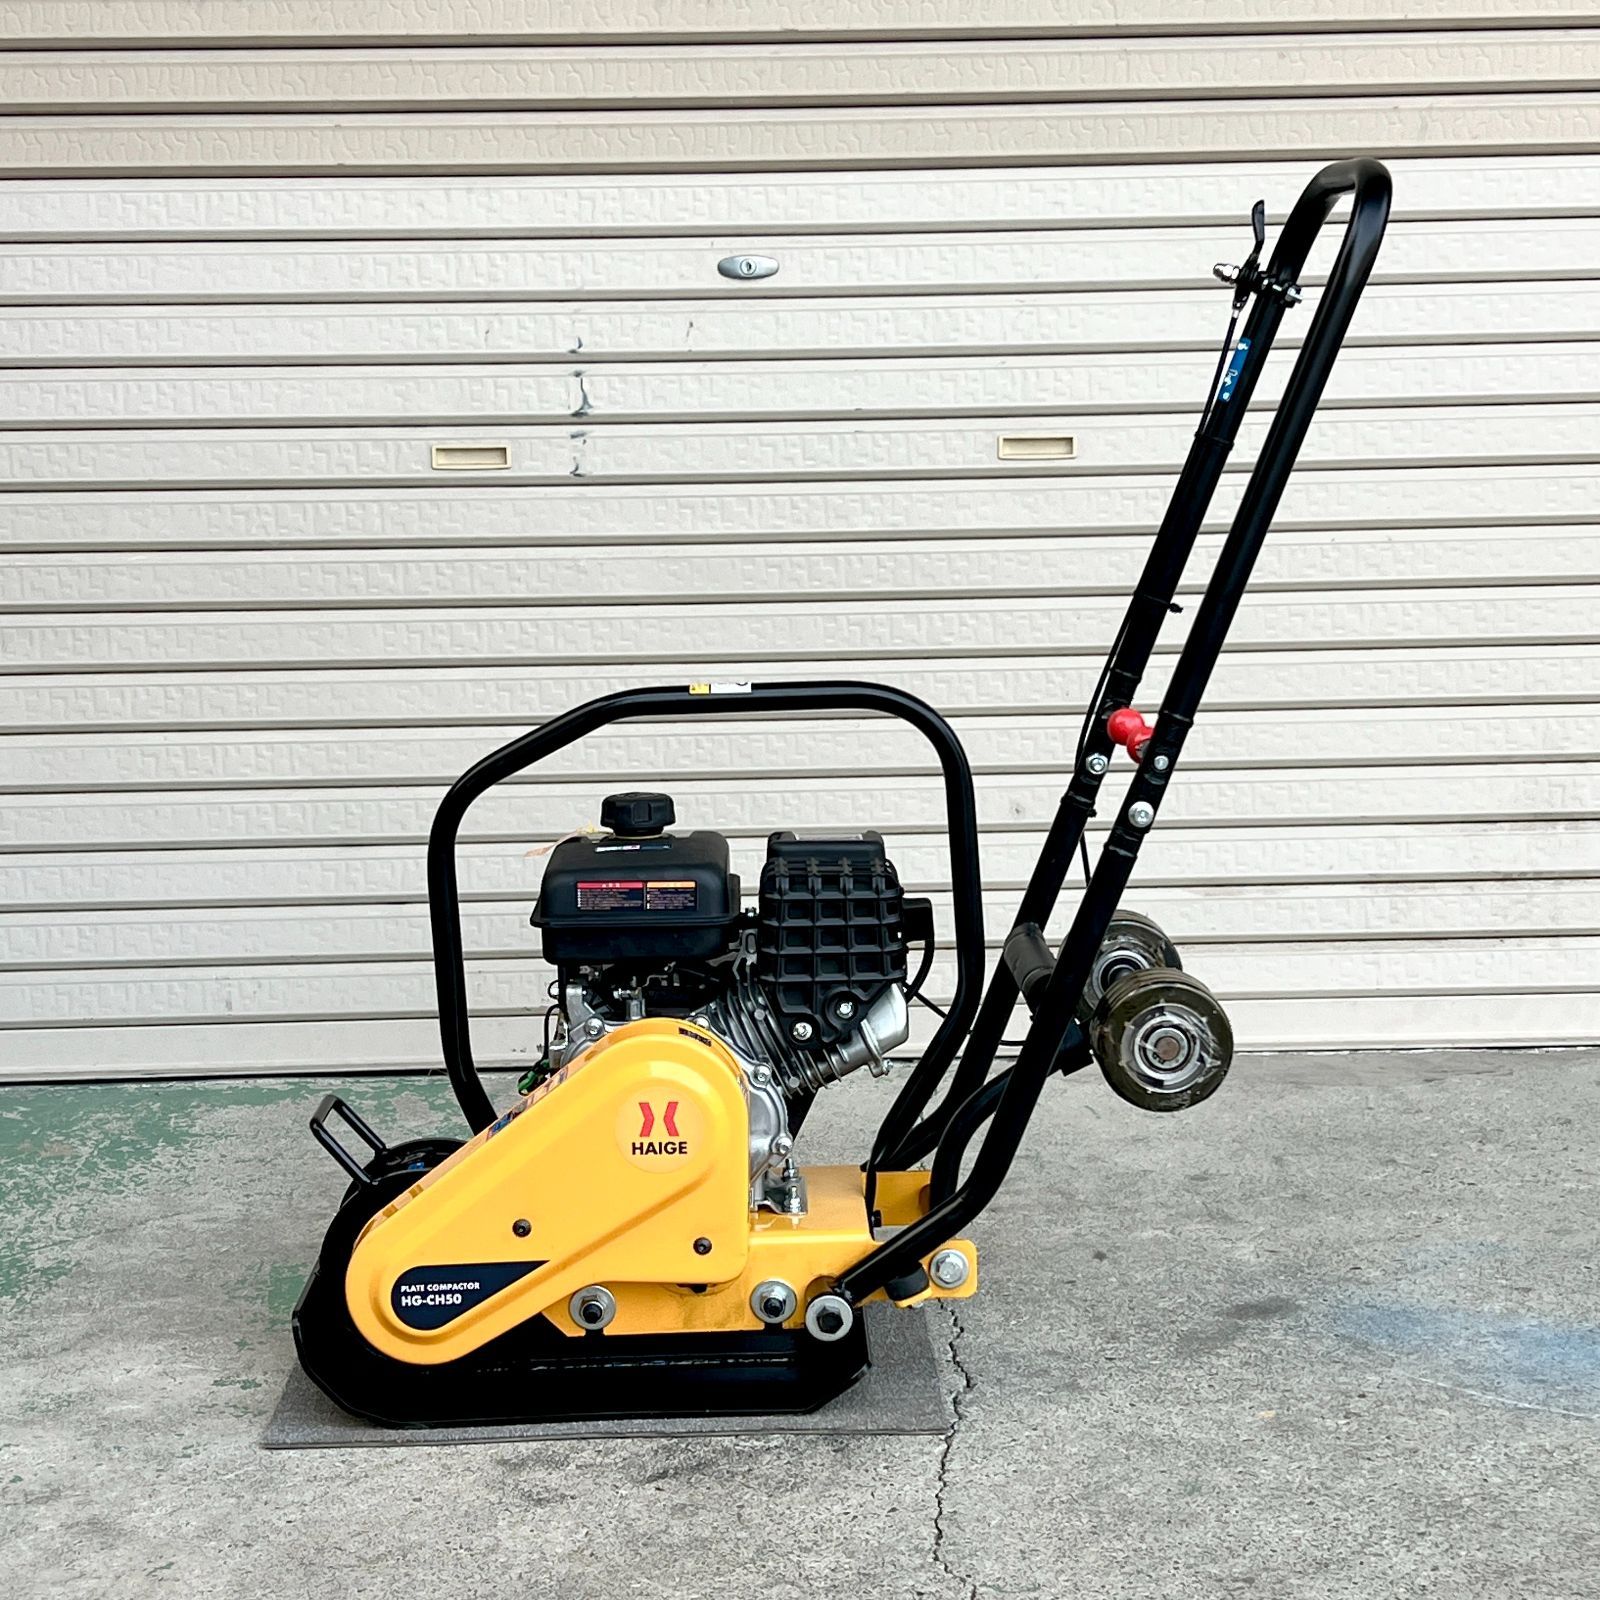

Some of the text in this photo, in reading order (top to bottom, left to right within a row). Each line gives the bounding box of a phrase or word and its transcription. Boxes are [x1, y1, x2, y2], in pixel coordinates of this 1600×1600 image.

[631, 1141, 688, 1155] HAIGE
[401, 1281, 480, 1292] PLATE COMPACTOR
[401, 1293, 462, 1306] HG-CH50
